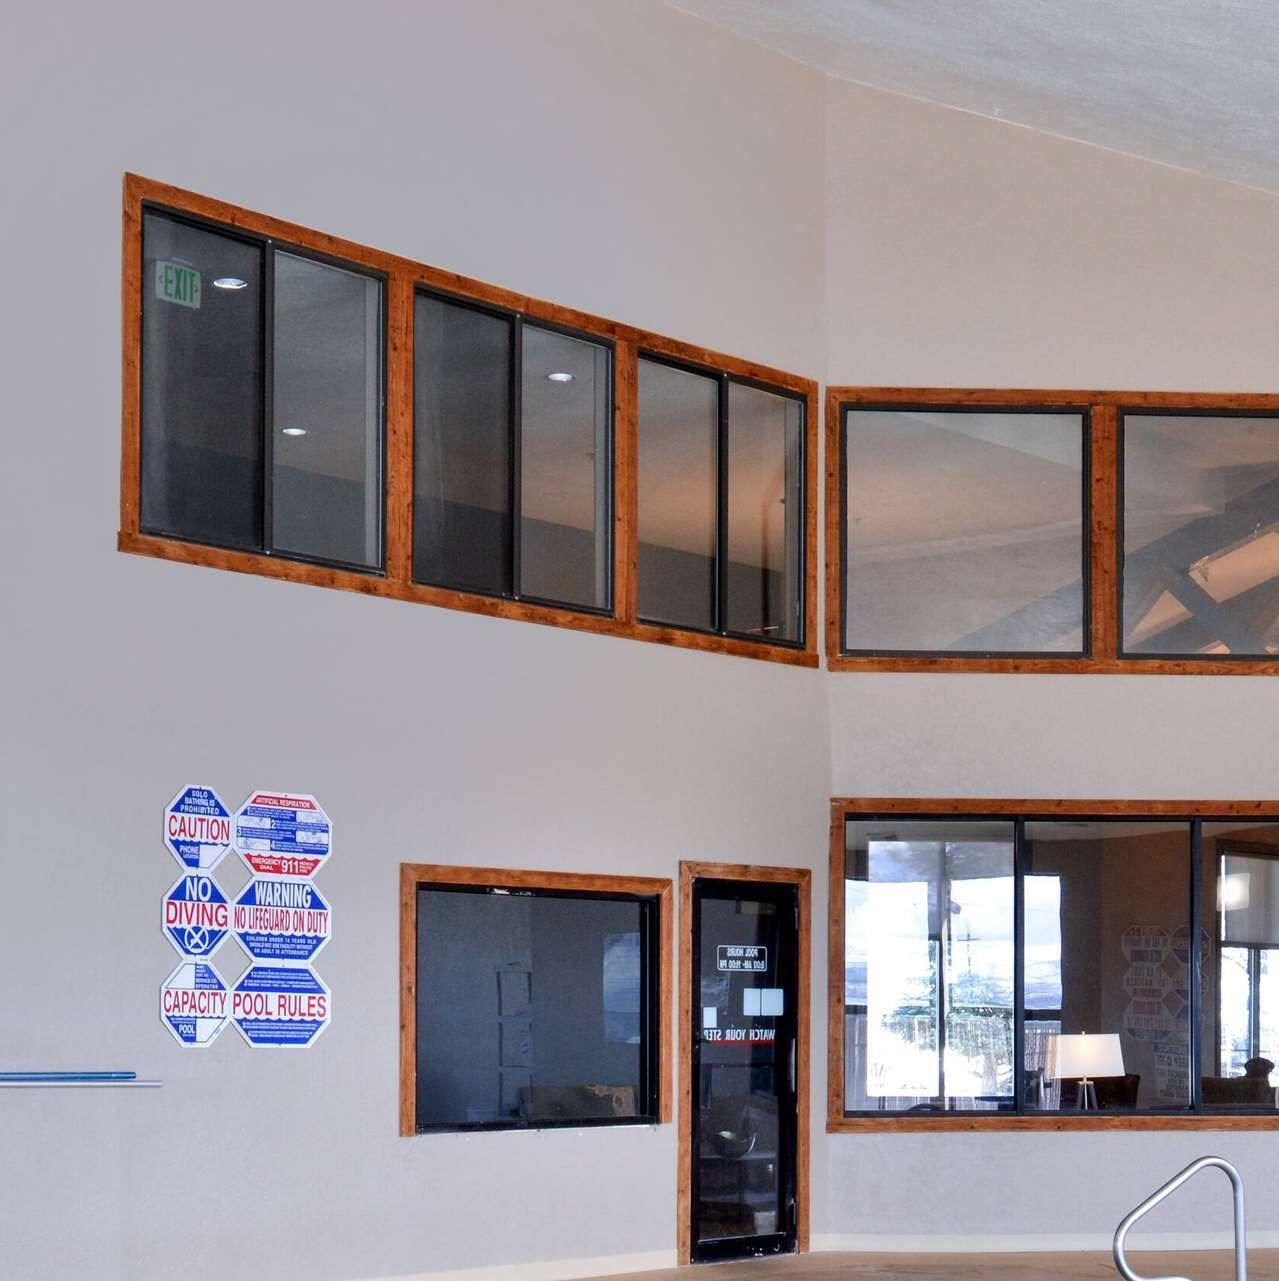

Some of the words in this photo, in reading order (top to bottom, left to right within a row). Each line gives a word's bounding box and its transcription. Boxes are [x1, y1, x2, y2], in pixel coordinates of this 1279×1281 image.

[164, 264, 198, 303] EXIT
[185, 797, 209, 806] BATHING
[209, 799, 216, 807] IS
[191, 790, 208, 798] SOLO
[256, 797, 279, 806] ARTIFICIAL
[279, 799, 311, 809] RESPIRATION
[180, 804, 220, 815] PROHIBITED
[168, 815, 230, 841] CAUTION
[180, 845, 199, 854] PHONE
[252, 858, 281, 866] EMERGENCY
[281, 860, 300, 873] 911
[186, 877, 212, 902] NO
[255, 881, 312, 909] WARNING
[166, 901, 228, 927] DIVING
[234, 906, 246, 929] NO
[248, 907, 290, 932] LIFEGUARD
[292, 910, 305, 933] ON
[307, 911, 328, 934] DUTY
[163, 990, 227, 1014] CAPACITY
[233, 993, 273, 1016] POOL
[278, 995, 327, 1017] RULES
[179, 1024, 196, 1034] POOL
